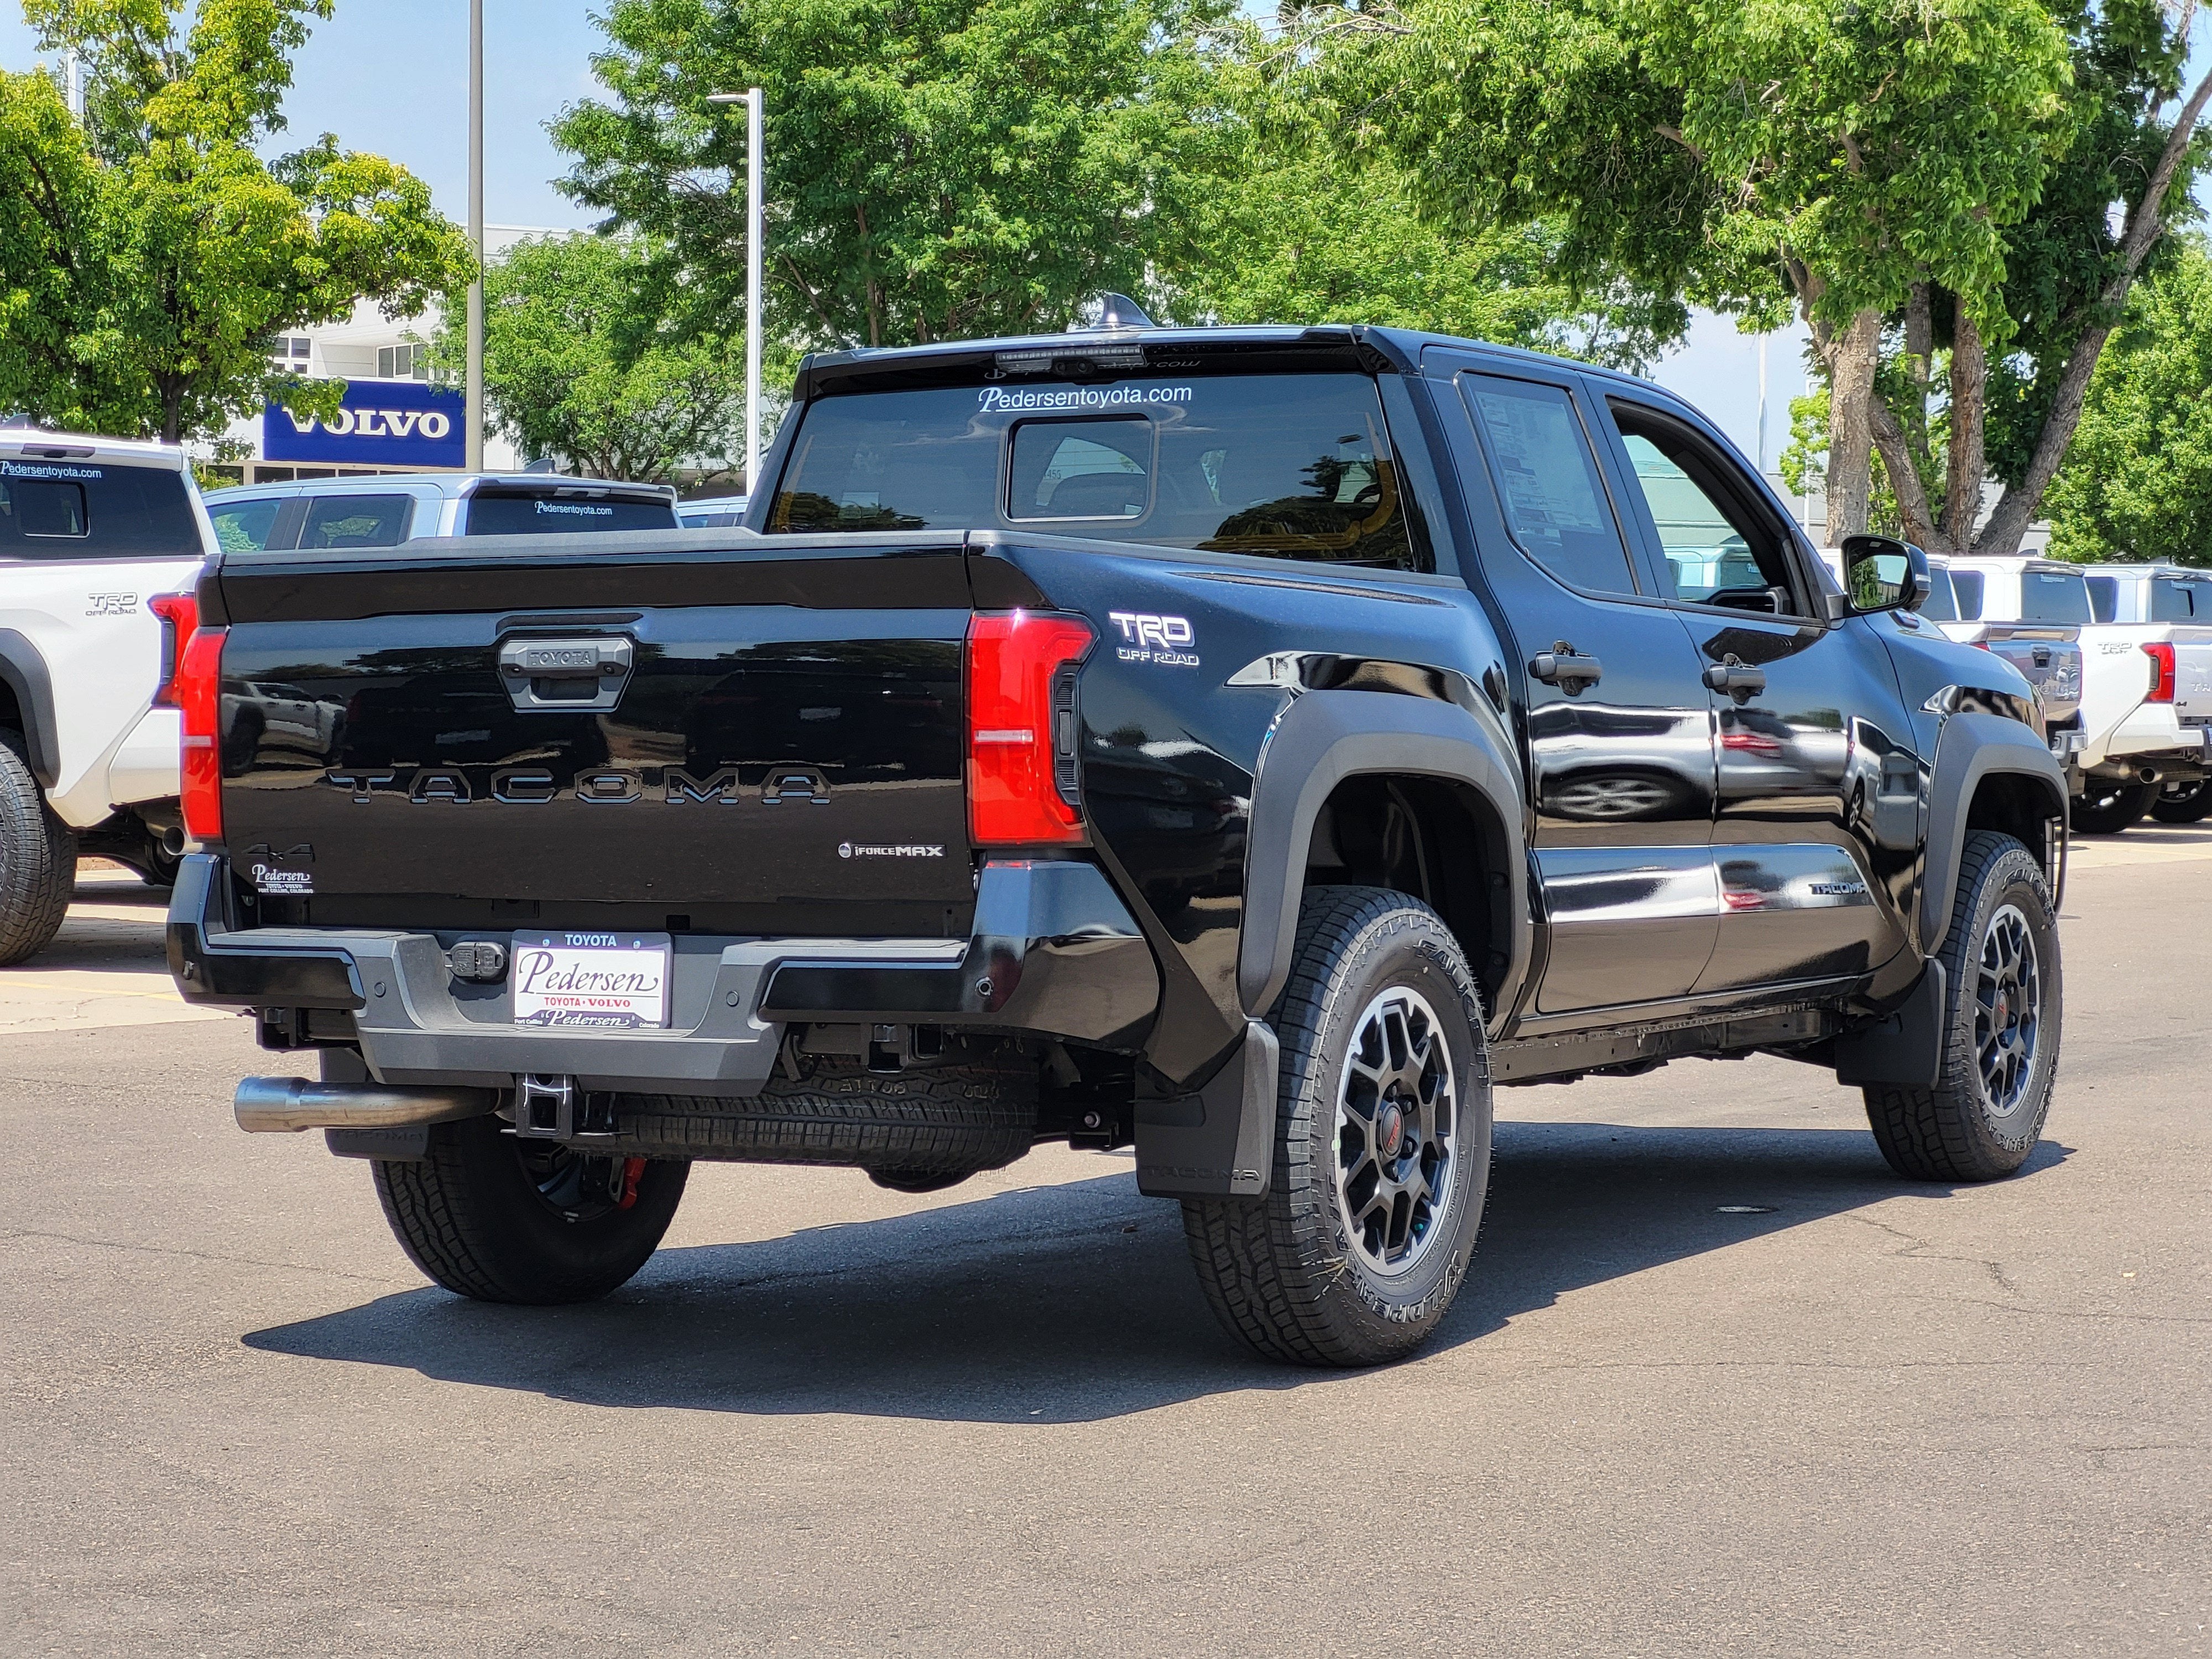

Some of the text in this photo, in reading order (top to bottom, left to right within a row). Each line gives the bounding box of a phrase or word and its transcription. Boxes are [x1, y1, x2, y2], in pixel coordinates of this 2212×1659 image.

[978, 387, 1192, 413] Pedersentoyota.com
[282, 406, 450, 439] VOLVO
[535, 501, 613, 515] Pedersentoyota.com
[88, 592, 138, 610] TRD
[1109, 612, 1193, 648] TRD
[529, 651, 592, 665] TOYOTA
[1116, 648, 1199, 666] OFF ROAD
[326, 768, 832, 805] TACOMA
[252, 864, 312, 883] Pedersen
[1808, 882, 1870, 895] TACOMA
[565, 934, 617, 947] TOYOTA
[519, 951, 659, 994] Pedersen
[587, 998, 630, 1007] VOLVO
[545, 1009, 630, 1028] Pedersen
